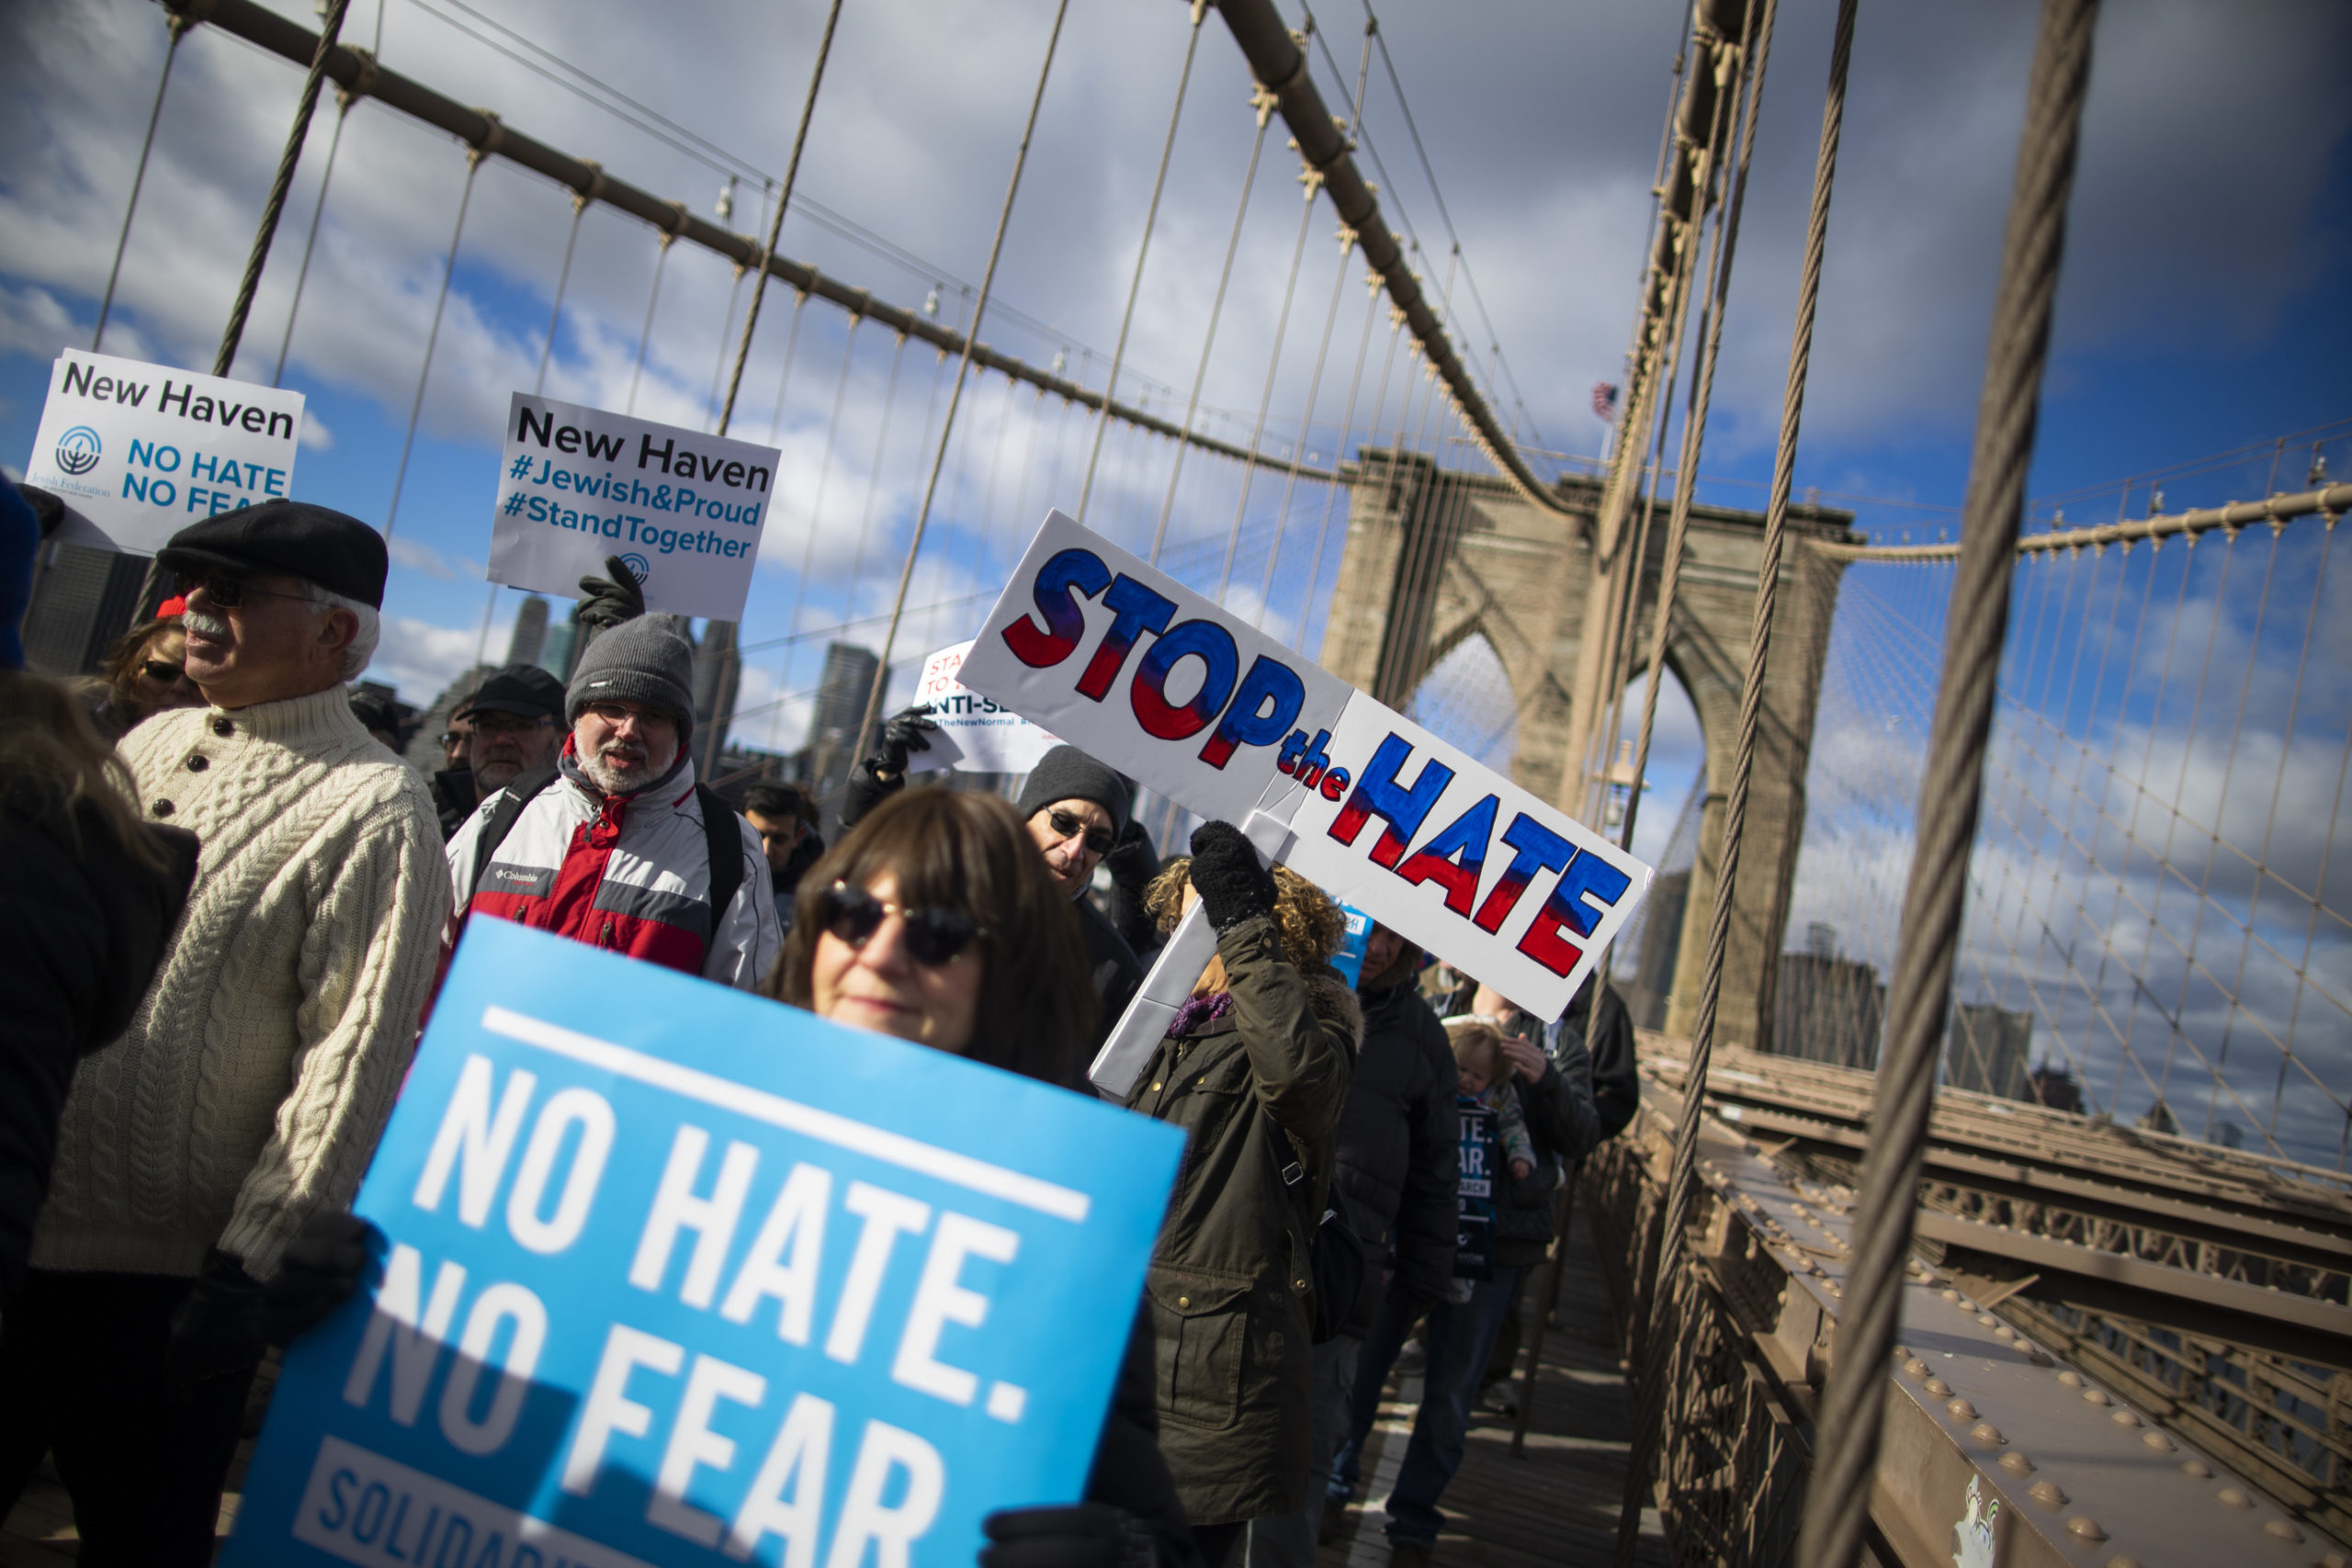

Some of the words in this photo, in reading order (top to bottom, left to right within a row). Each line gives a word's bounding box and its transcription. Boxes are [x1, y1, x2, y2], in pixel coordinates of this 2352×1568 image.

[62, 362, 149, 407] New
[158, 380, 294, 440] Haven
[128, 438, 181, 472] NO
[191, 452, 286, 496] HATE
[516, 407, 626, 462] New
[638, 434, 770, 491] Haven
[60, 478, 110, 498] Federation
[122, 472, 176, 506] NO
[509, 454, 761, 526] #Jewish&Proud
[504, 492, 751, 558] #StandTogether
[926, 676, 949, 695] TO
[930, 654, 961, 675] STA
[1001, 548, 1306, 770] STOP
[1276, 728, 1351, 802] the
[1328, 732, 1632, 979] HATE
[503, 871, 537, 882] Columbia
[1459, 1117, 1492, 1143] TE.
[1458, 1146, 1491, 1176] AR.
[412, 1053, 616, 1255] NO
[628, 1123, 1027, 1425] HATE.
[342, 1242, 548, 1456] NO
[560, 1323, 944, 1568] FEAR
